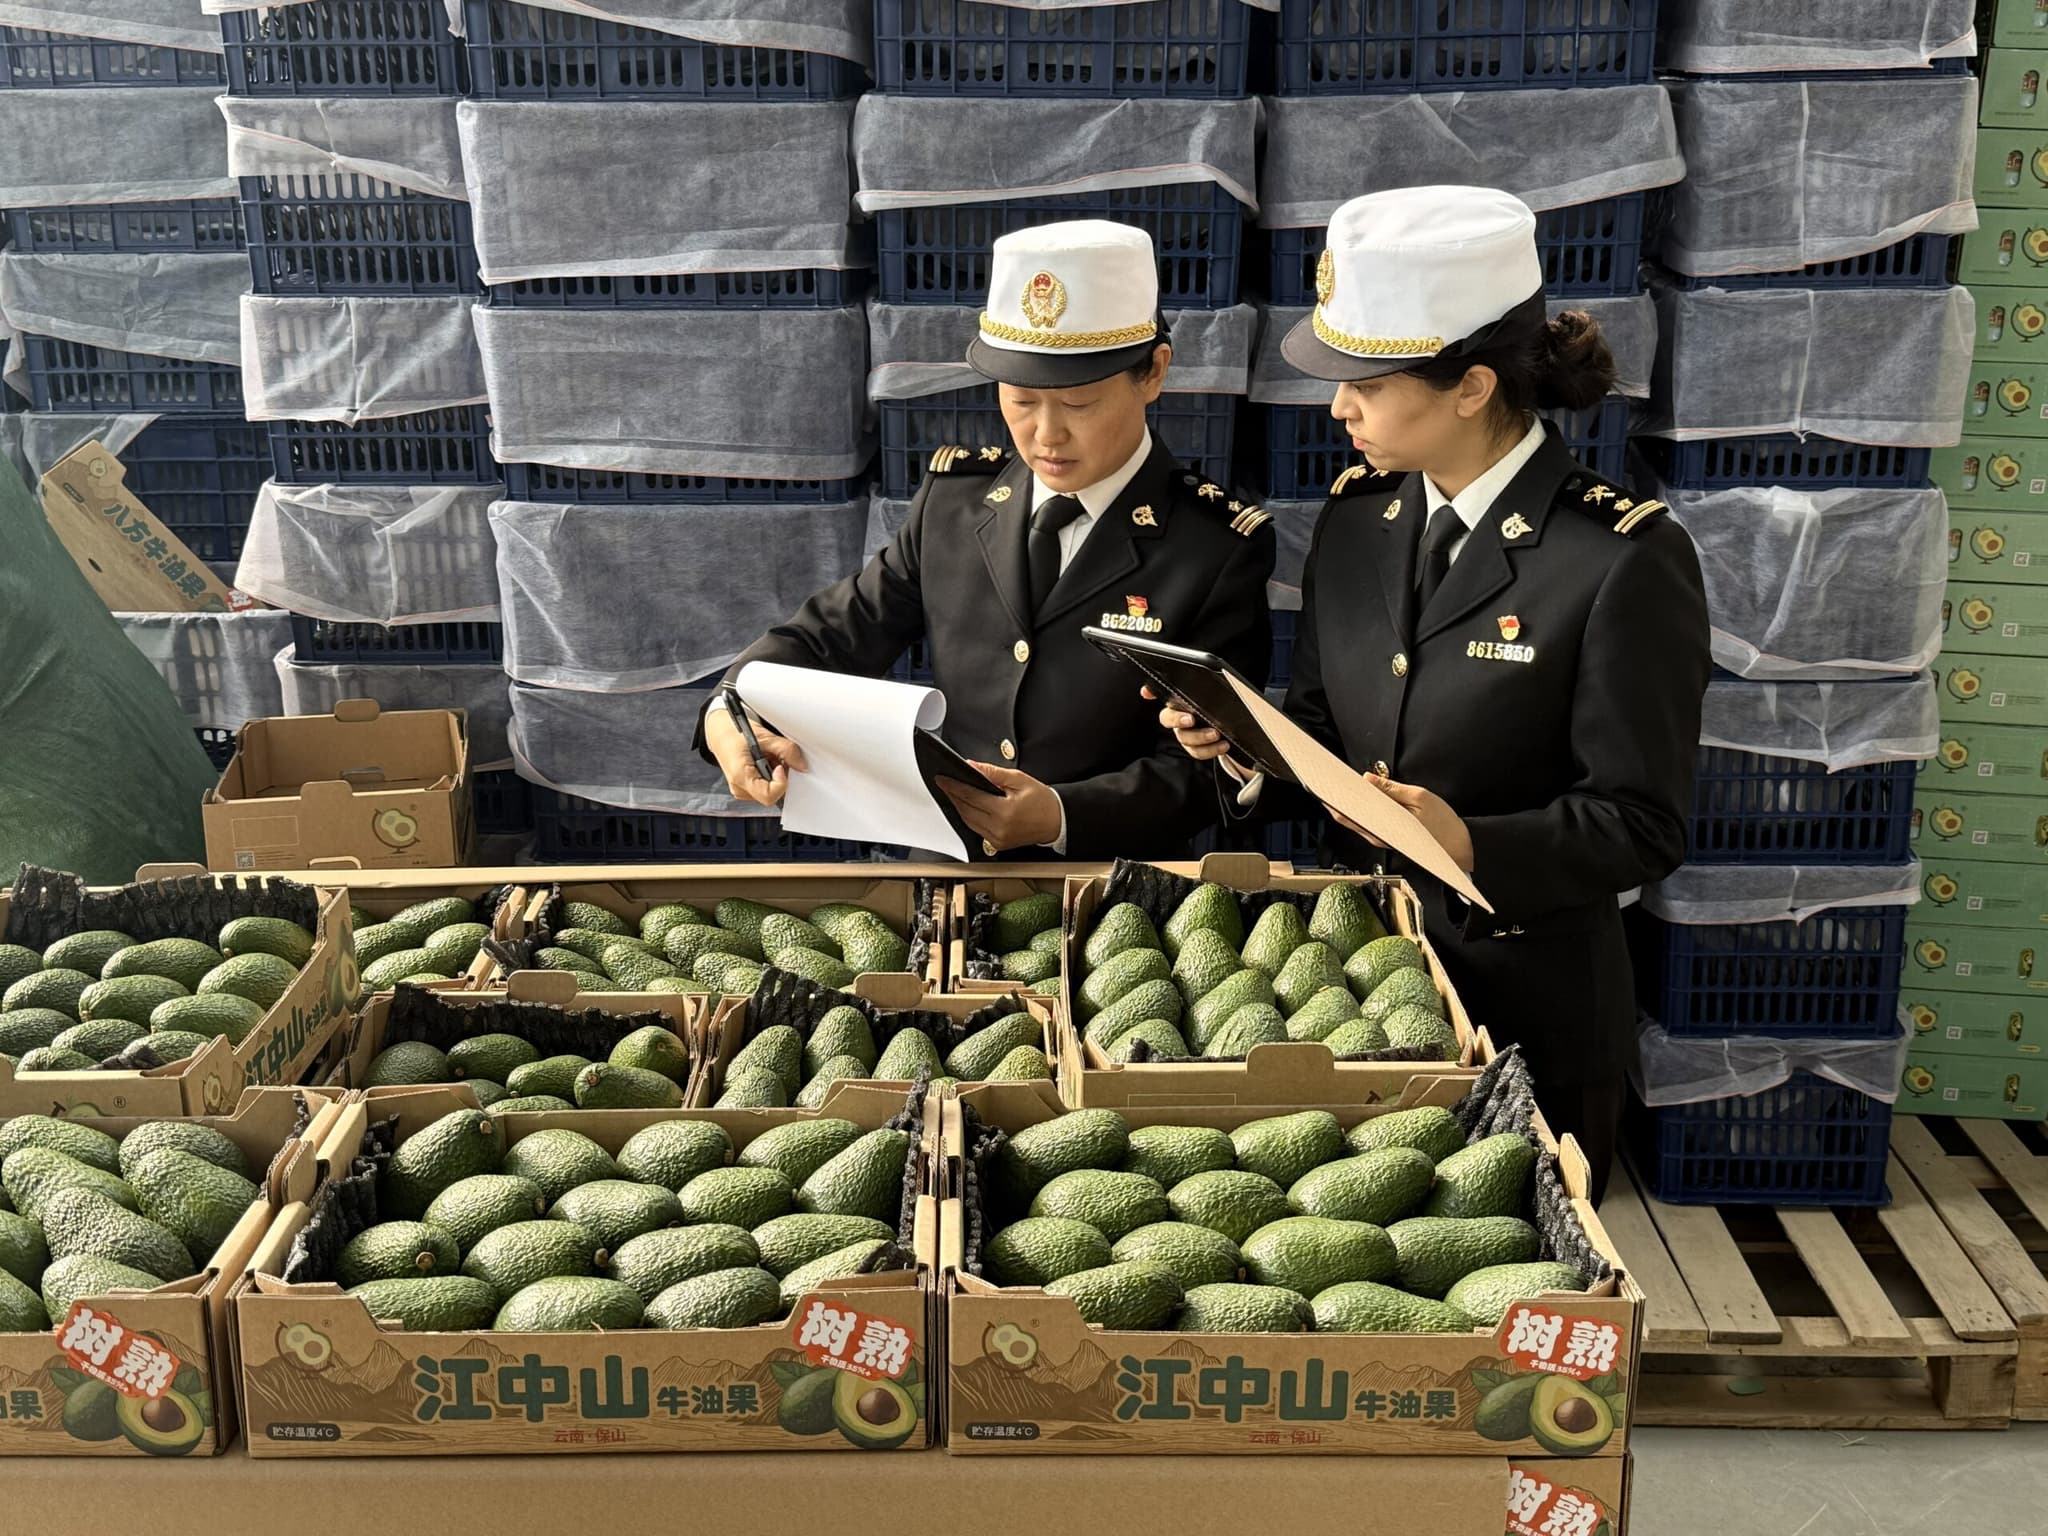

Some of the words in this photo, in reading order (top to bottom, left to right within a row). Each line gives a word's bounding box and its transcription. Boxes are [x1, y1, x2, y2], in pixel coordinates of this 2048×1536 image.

[103, 503, 207, 599] 八方牛油果
[1101, 613, 1162, 633] 8622080
[1466, 641, 1534, 662] 8615850
[62, 1308, 174, 1397] 树熟
[800, 1302, 910, 1375] 树熟
[1507, 1309, 1618, 1371] 树熟
[0, 1390, 43, 1420] 果
[415, 1353, 649, 1423] 江中山
[656, 1385, 760, 1415] 牛油果
[1117, 1355, 1349, 1423] 江中山
[1355, 1390, 1456, 1419] 牛油果
